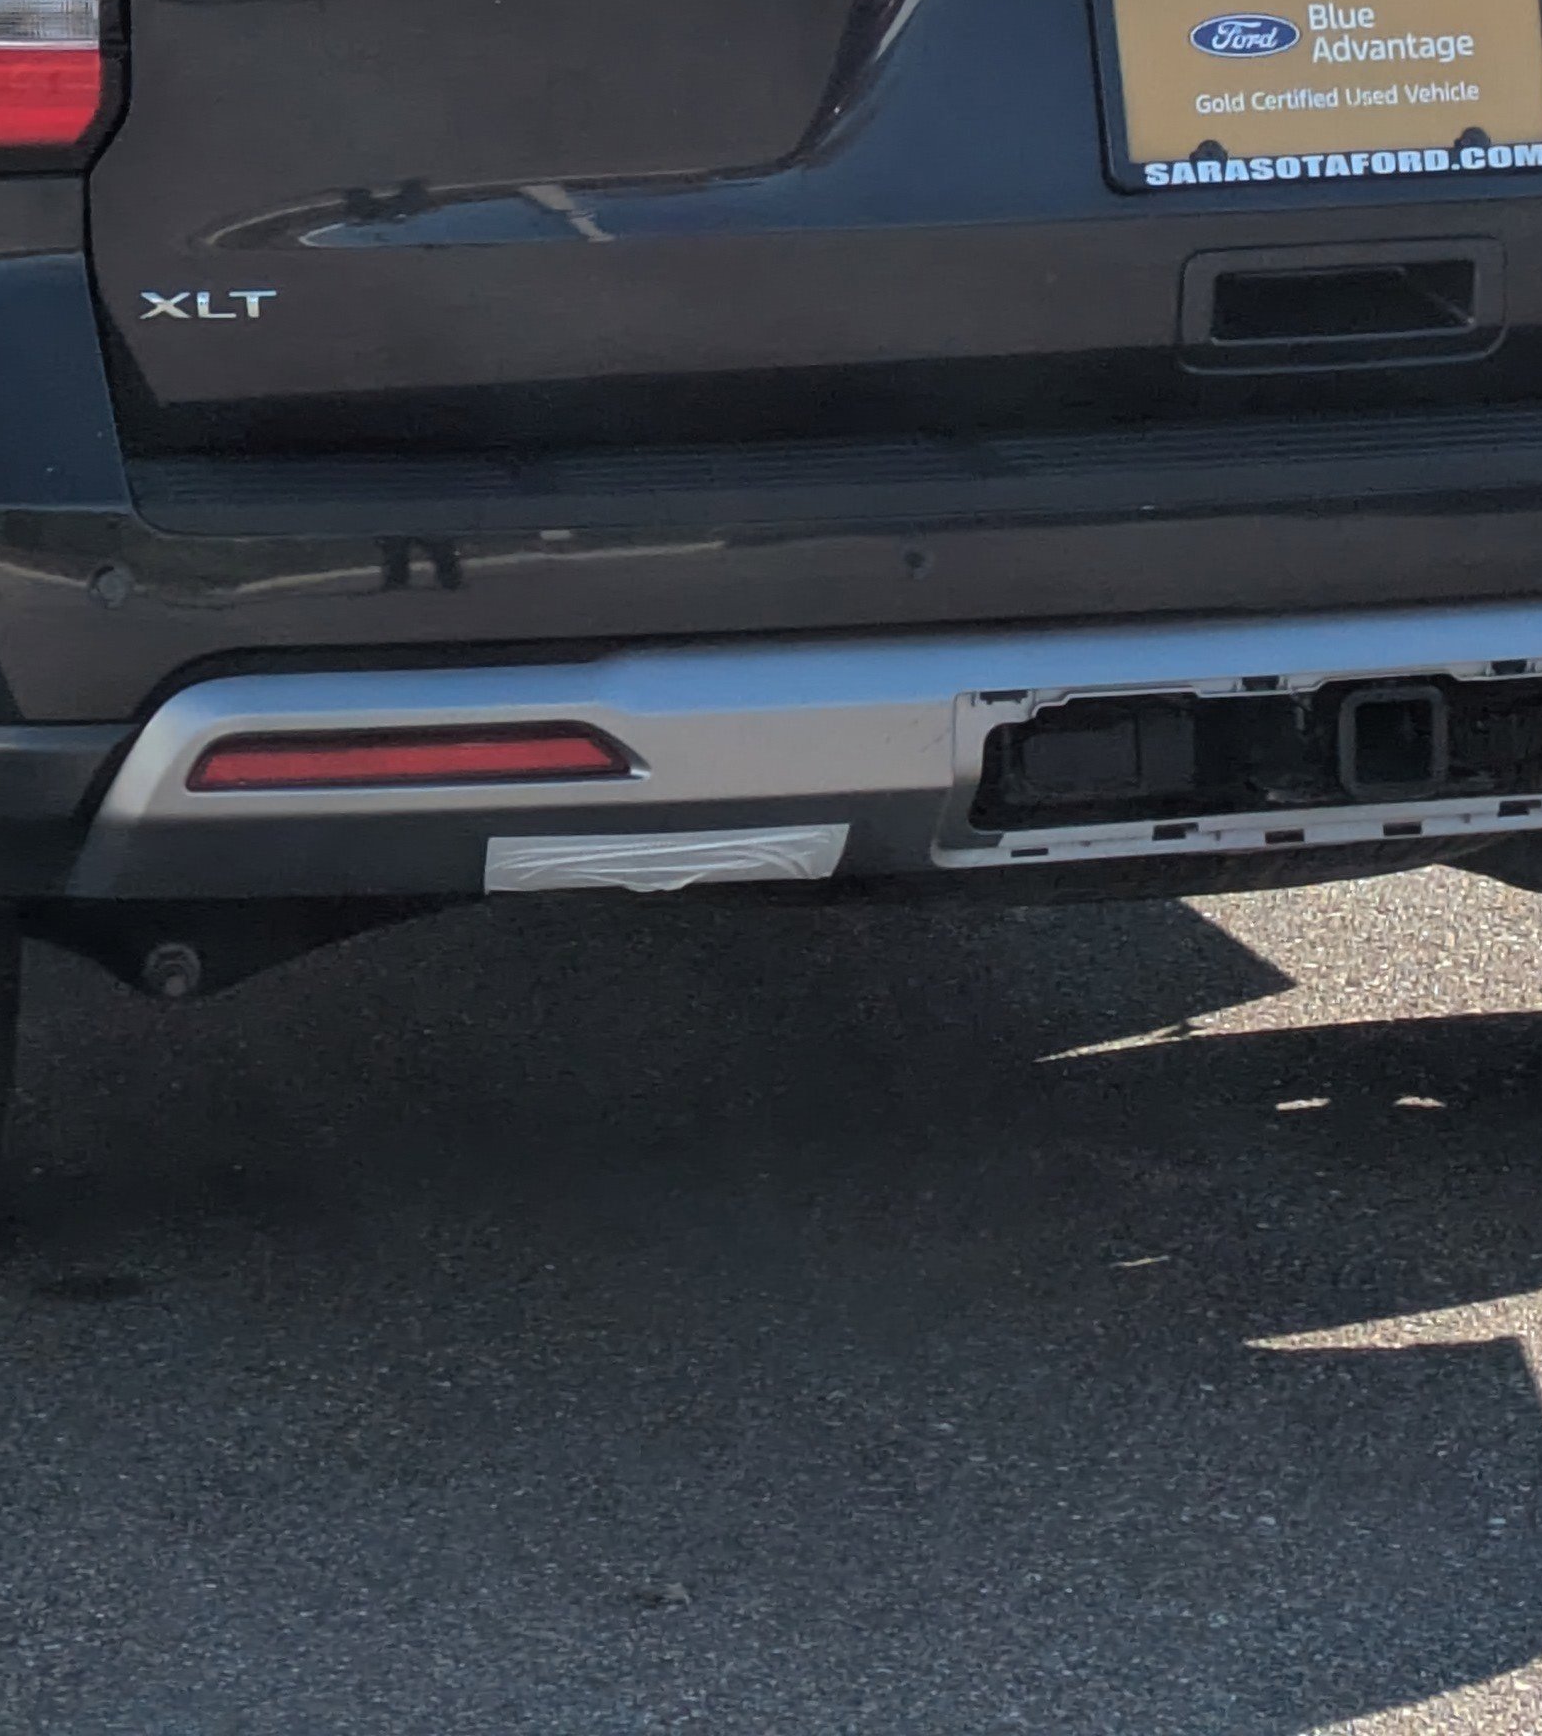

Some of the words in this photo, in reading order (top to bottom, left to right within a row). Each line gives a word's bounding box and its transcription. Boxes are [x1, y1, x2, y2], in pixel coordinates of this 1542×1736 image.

[1307, 2, 1375, 32] Blue
[1211, 20, 1279, 52] Ford
[1313, 33, 1474, 63] Advantage
[1195, 93, 1246, 115] Gold
[1251, 88, 1339, 112] Certified
[1345, 85, 1399, 108] Used
[1404, 81, 1480, 104] Vehicle
[139, 290, 277, 319] XLT
